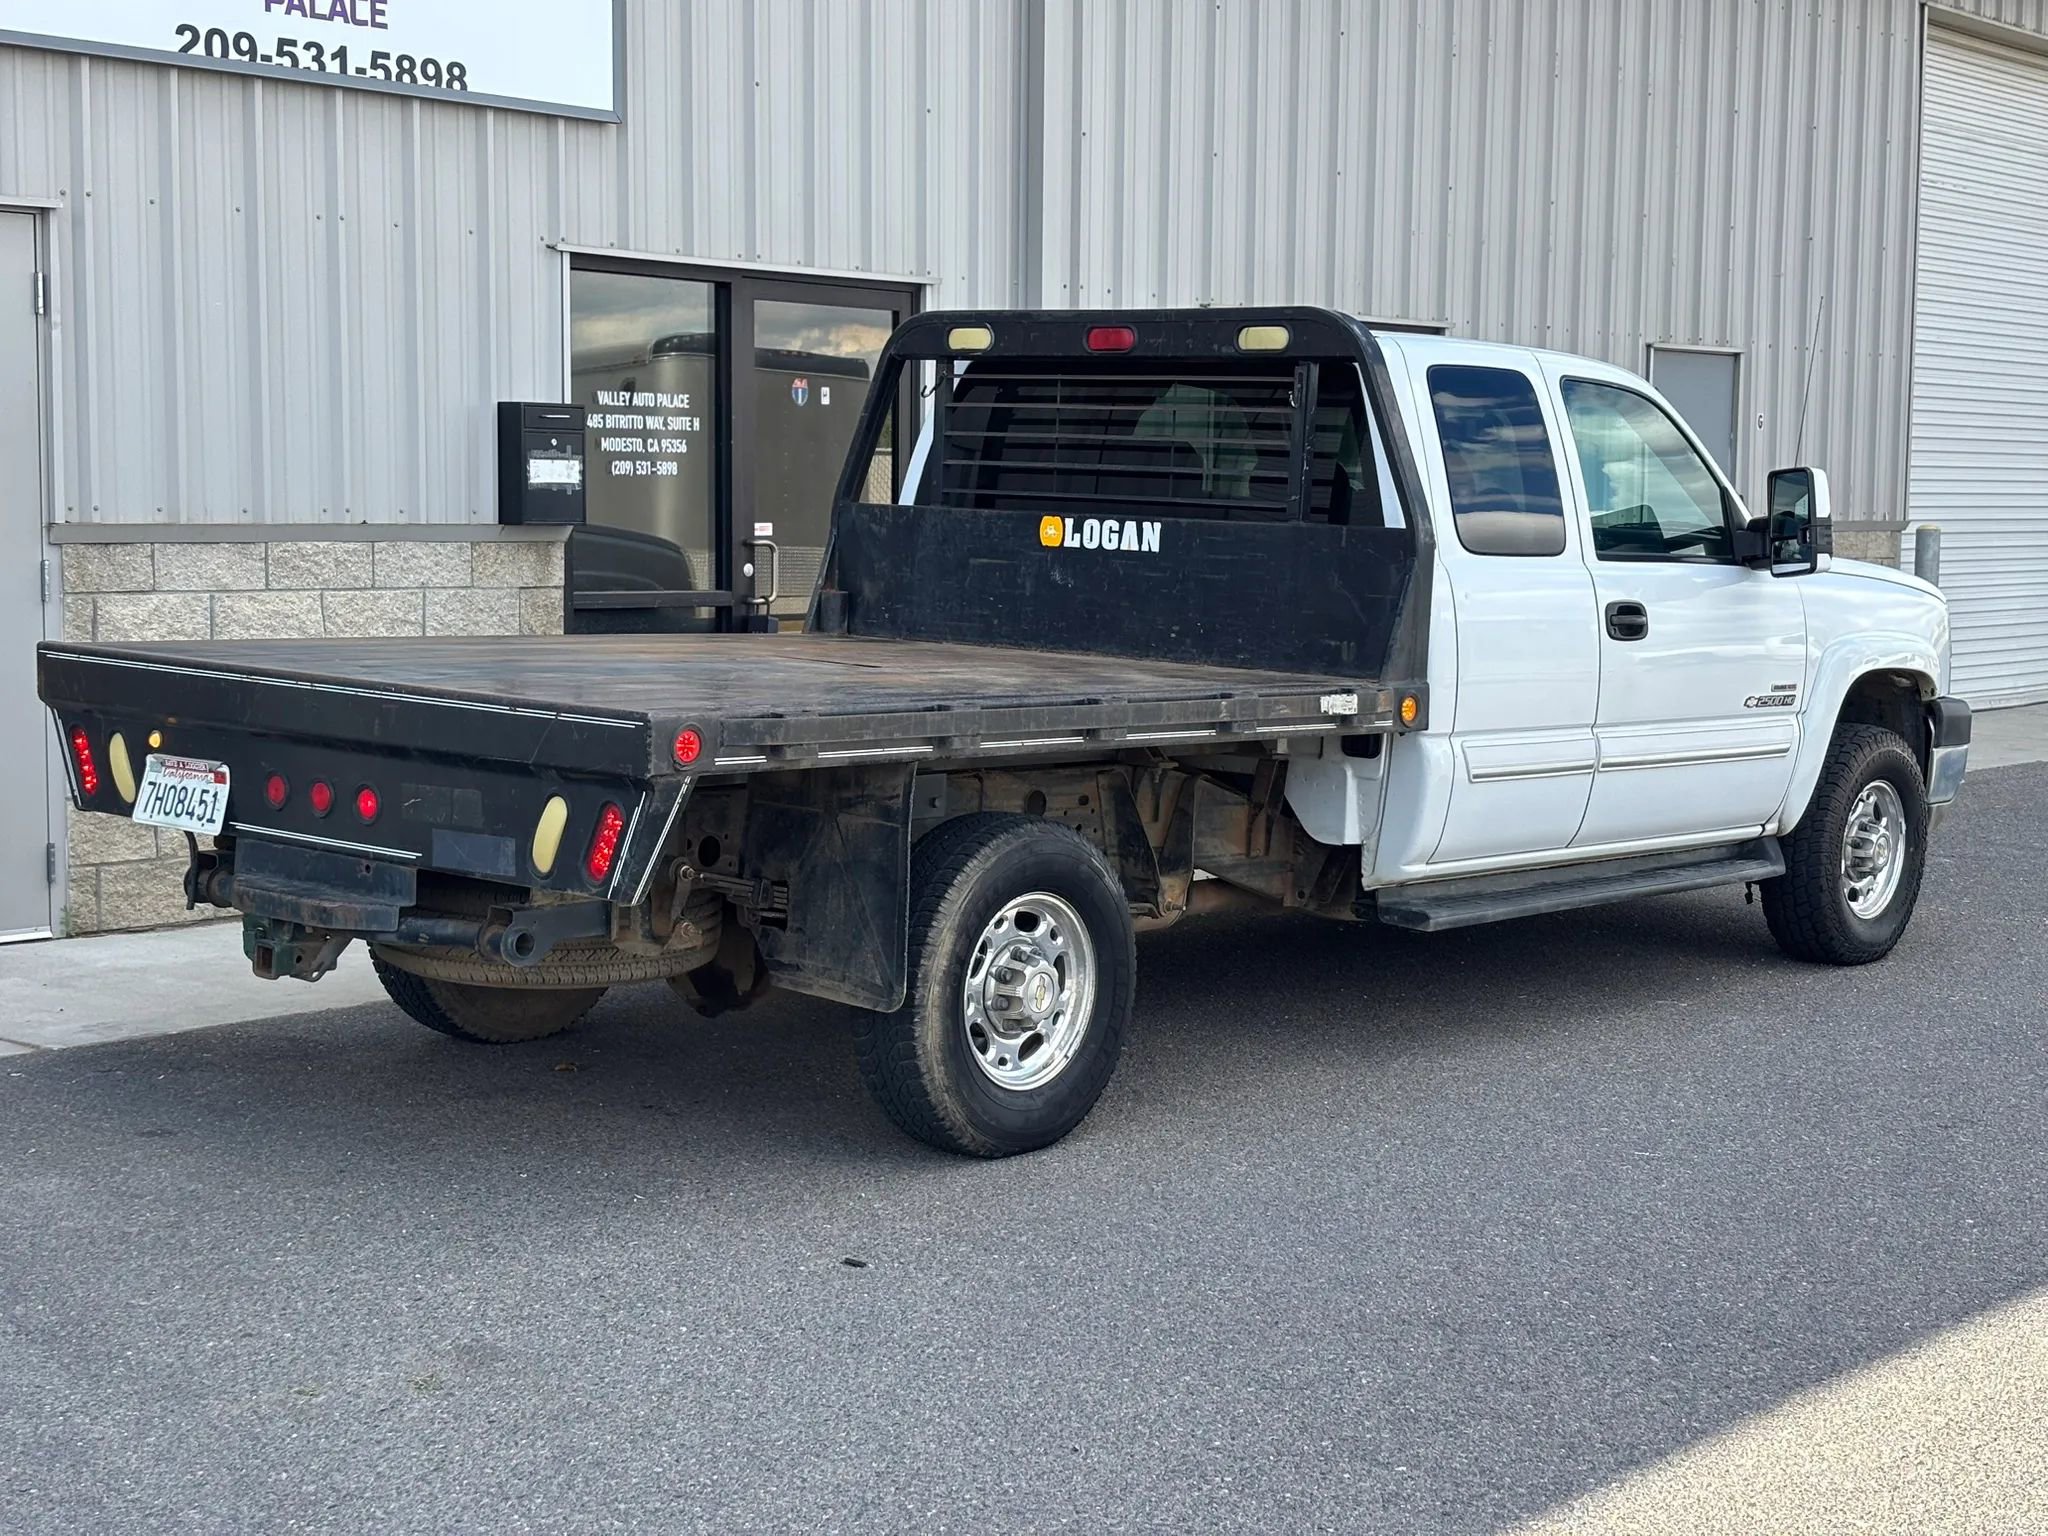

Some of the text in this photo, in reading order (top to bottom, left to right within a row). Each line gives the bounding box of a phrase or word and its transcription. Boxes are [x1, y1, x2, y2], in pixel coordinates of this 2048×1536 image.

[175, 24, 468, 91] 209-531-5898
[597, 390, 690, 408] VALLEY AUTO PALACE
[586, 413, 604, 429] 485
[605, 414, 644, 430] BITRITTO
[667, 416, 692, 431] SUITE
[693, 417, 700, 431] H
[601, 437, 687, 454] MODESTO, CA 95356
[611, 460, 678, 477] (209) 531-5898
[1063, 517, 1162, 553] LOGAN
[1758, 696, 1783, 705] 2500
[143, 781, 219, 824] 7H08451
